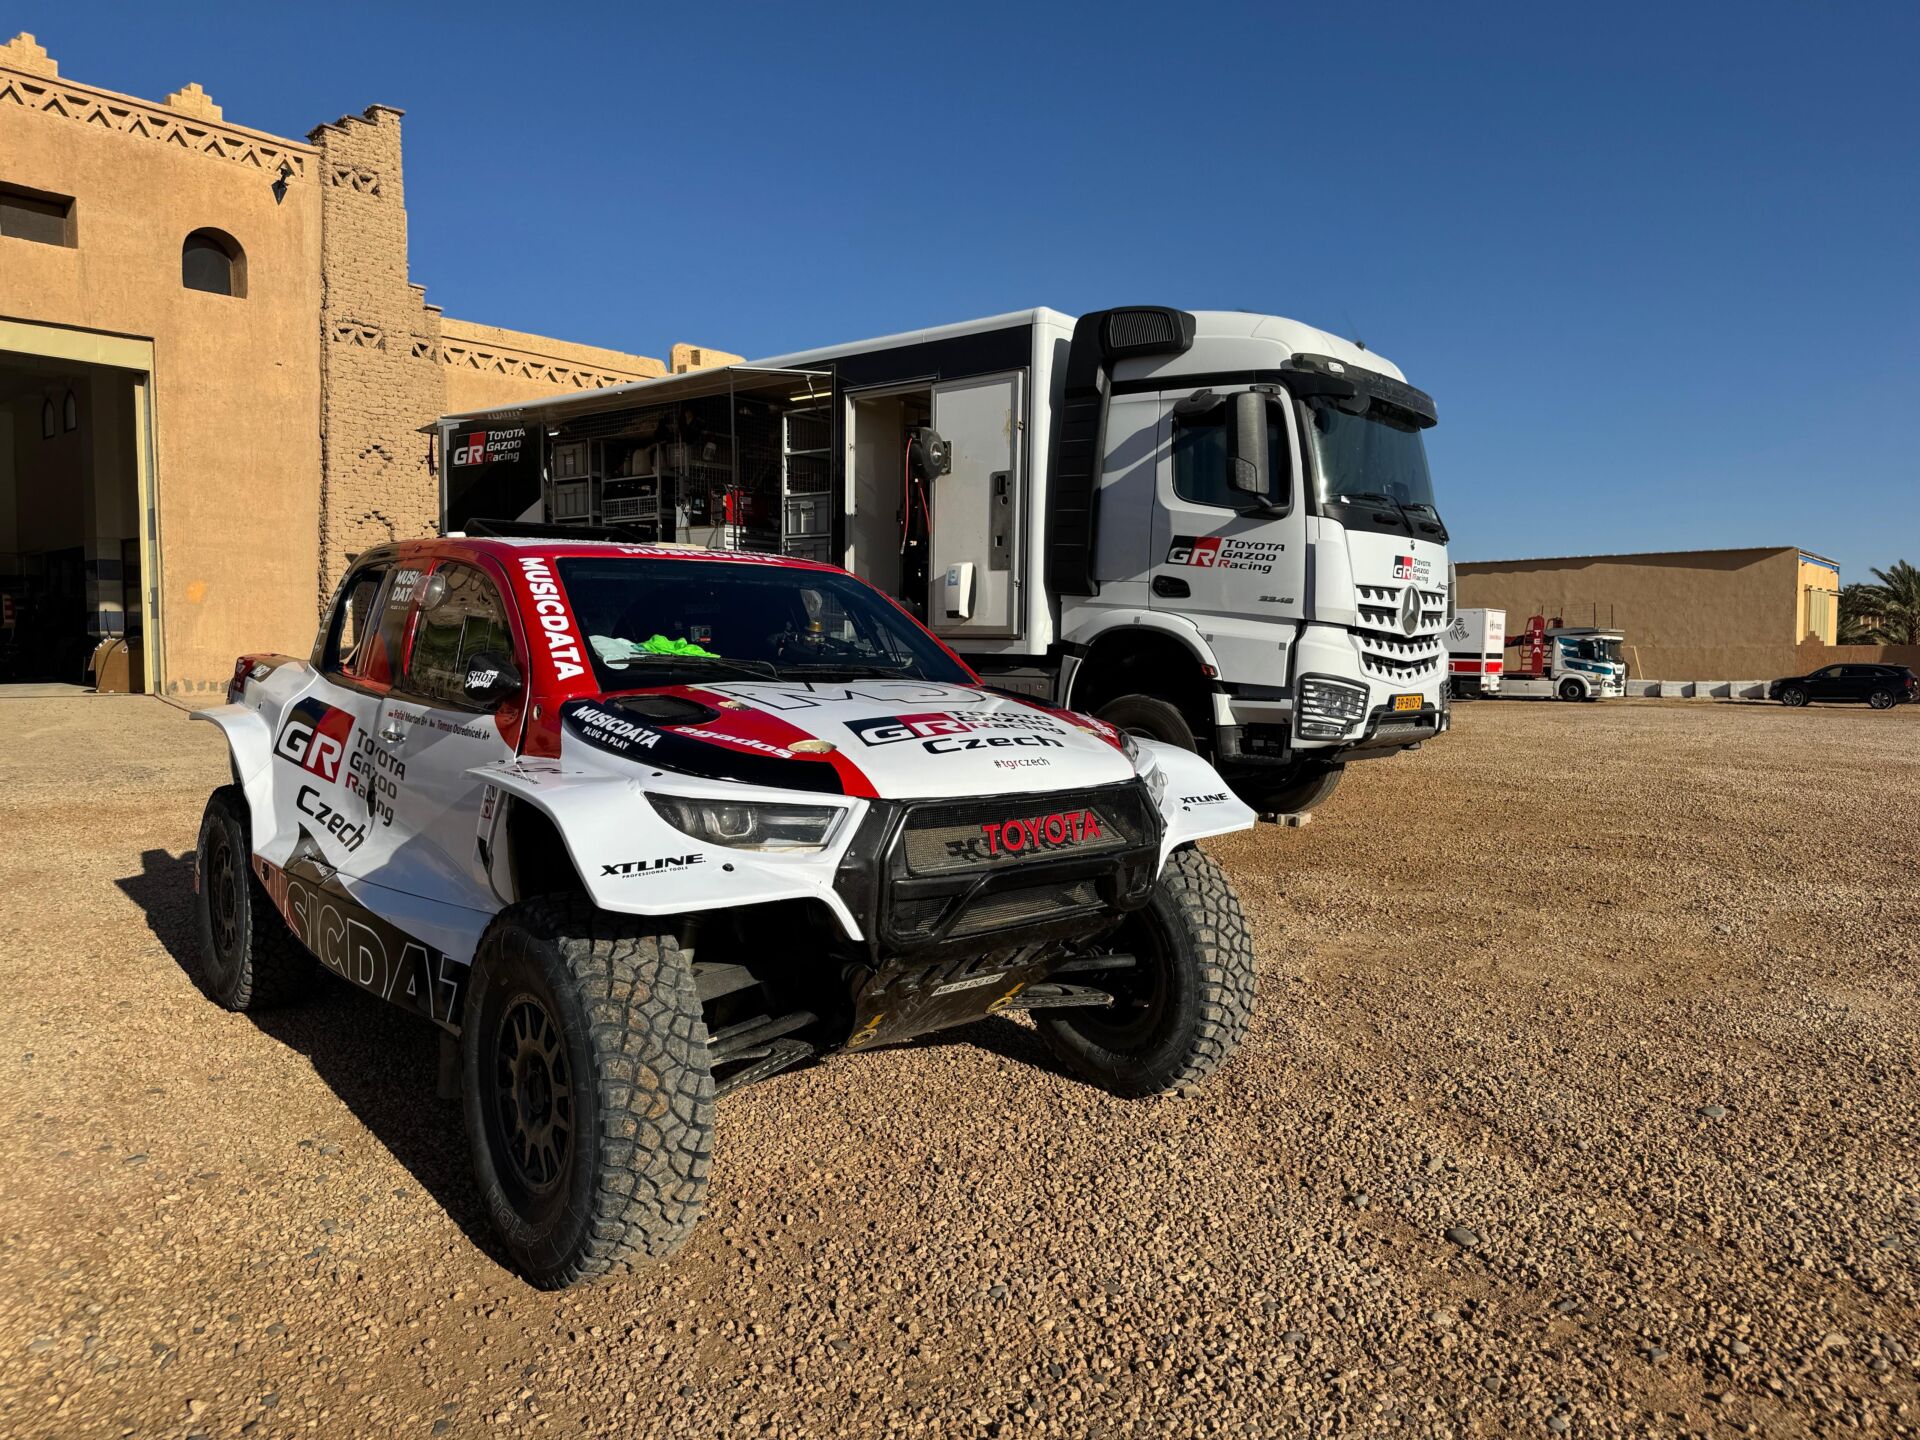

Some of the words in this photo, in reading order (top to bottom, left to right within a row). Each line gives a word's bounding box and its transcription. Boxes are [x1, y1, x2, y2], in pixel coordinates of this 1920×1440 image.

[488, 428, 526, 440] TOYOTA
[454, 445, 484, 465] GR
[486, 440, 521, 452] GAZOO
[485, 451, 520, 463] Racing
[1221, 549, 1276, 561] GAZOO
[1225, 539, 1285, 551] TOYOTA
[1167, 547, 1216, 567] GR
[1217, 559, 1272, 574] Racing
[518, 557, 585, 681] MUSICDATA
[571, 705, 662, 749] MUSICDATA
[860, 719, 966, 744] GR
[966, 722, 1067, 735] Racing
[582, 725, 601, 739] PLUG
[601, 733, 608, 742] &
[609, 736, 630, 750] PLAY
[673, 726, 795, 759] agados
[922, 734, 1064, 755] Czech
[278, 720, 342, 779] GR
[993, 756, 1050, 770] #tgrczech
[1179, 792, 1230, 804] XTLINE
[296, 784, 366, 853] Czech
[982, 811, 1101, 855] TOYOTA
[600, 853, 705, 877] XTLINE
[622, 869, 667, 879] PROFESSIONAL
